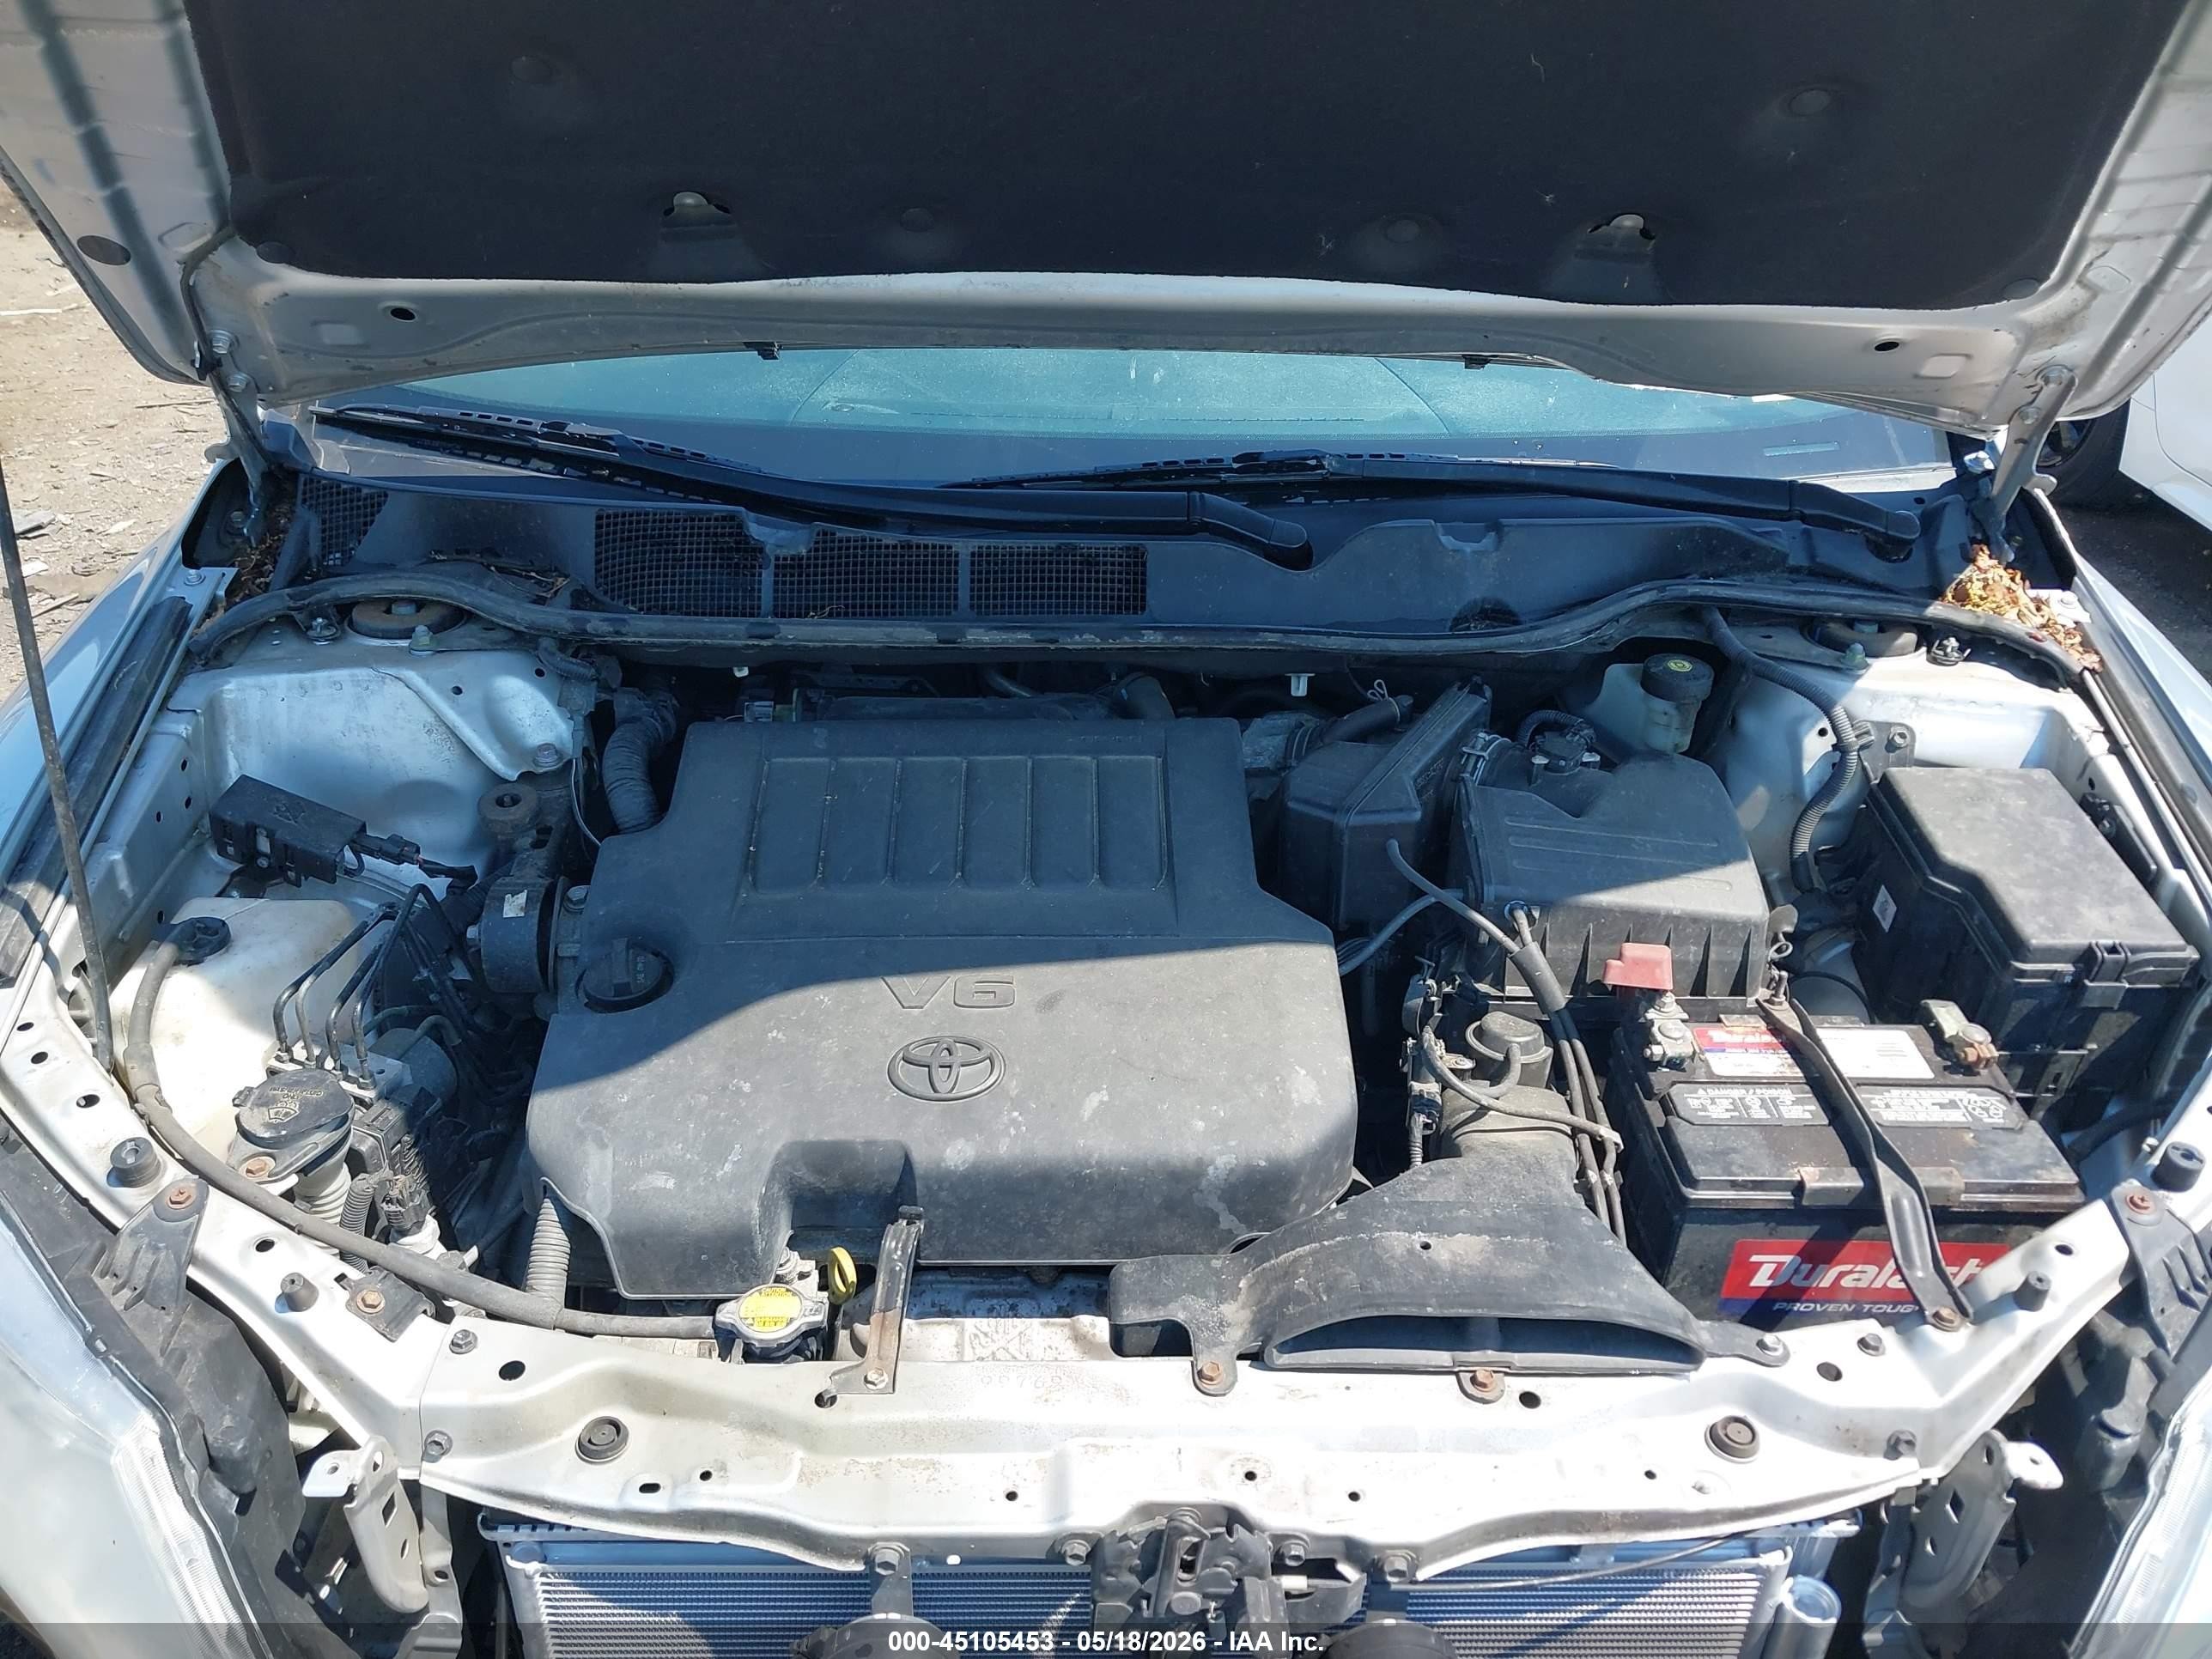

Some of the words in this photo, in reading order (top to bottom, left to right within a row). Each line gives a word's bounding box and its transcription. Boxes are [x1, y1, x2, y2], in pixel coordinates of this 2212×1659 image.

[881, 973, 1016, 1010] V6
[1772, 1302, 1855, 1313] PROVEN
[1863, 1304, 1920, 1314] TOUG
